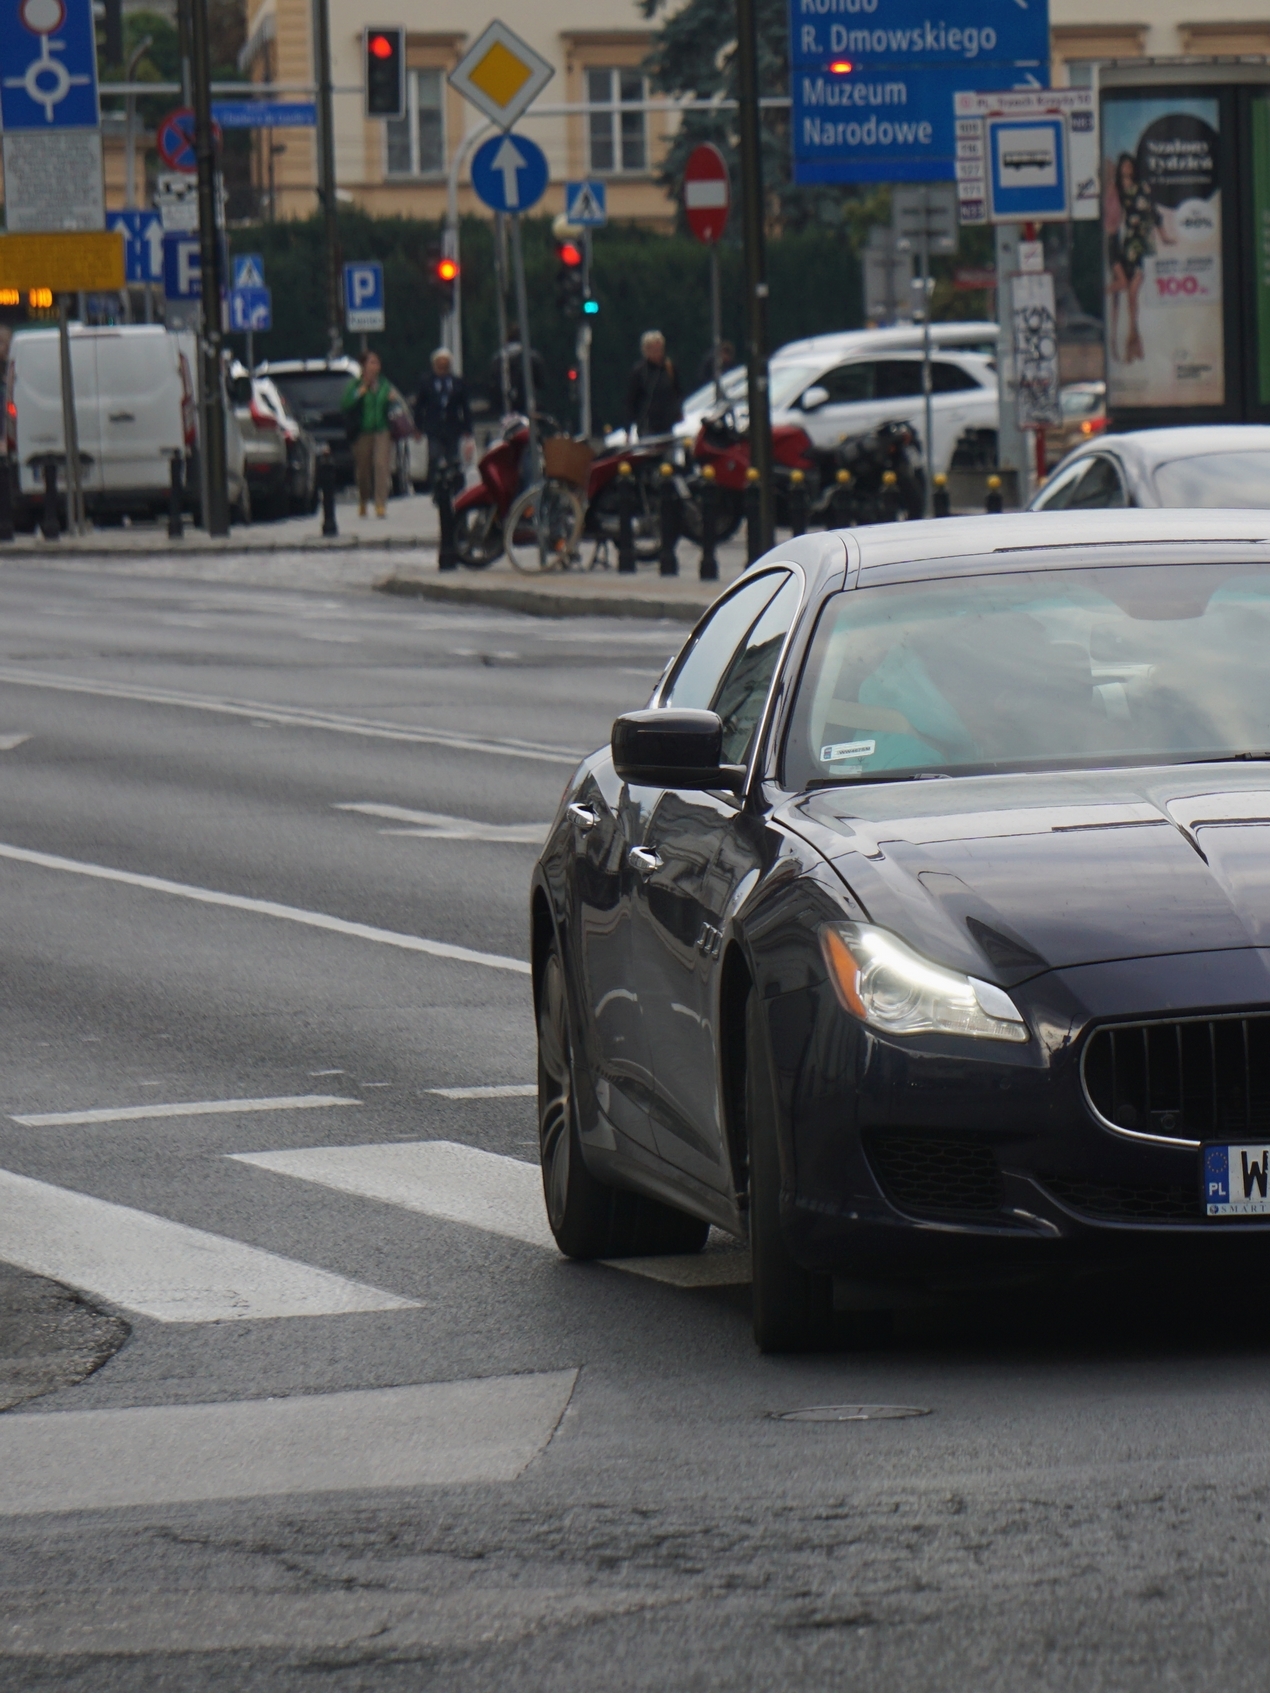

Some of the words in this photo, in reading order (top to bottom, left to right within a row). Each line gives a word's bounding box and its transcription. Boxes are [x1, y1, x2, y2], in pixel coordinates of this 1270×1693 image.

[801, 24, 823, 53] R.
[830, 20, 997, 57] Dmowskiego
[803, 77, 908, 106] Muzeum
[803, 116, 933, 146] Narodowe
[353, 270, 375, 307] P
[1209, 1183, 1226, 1196] PL
